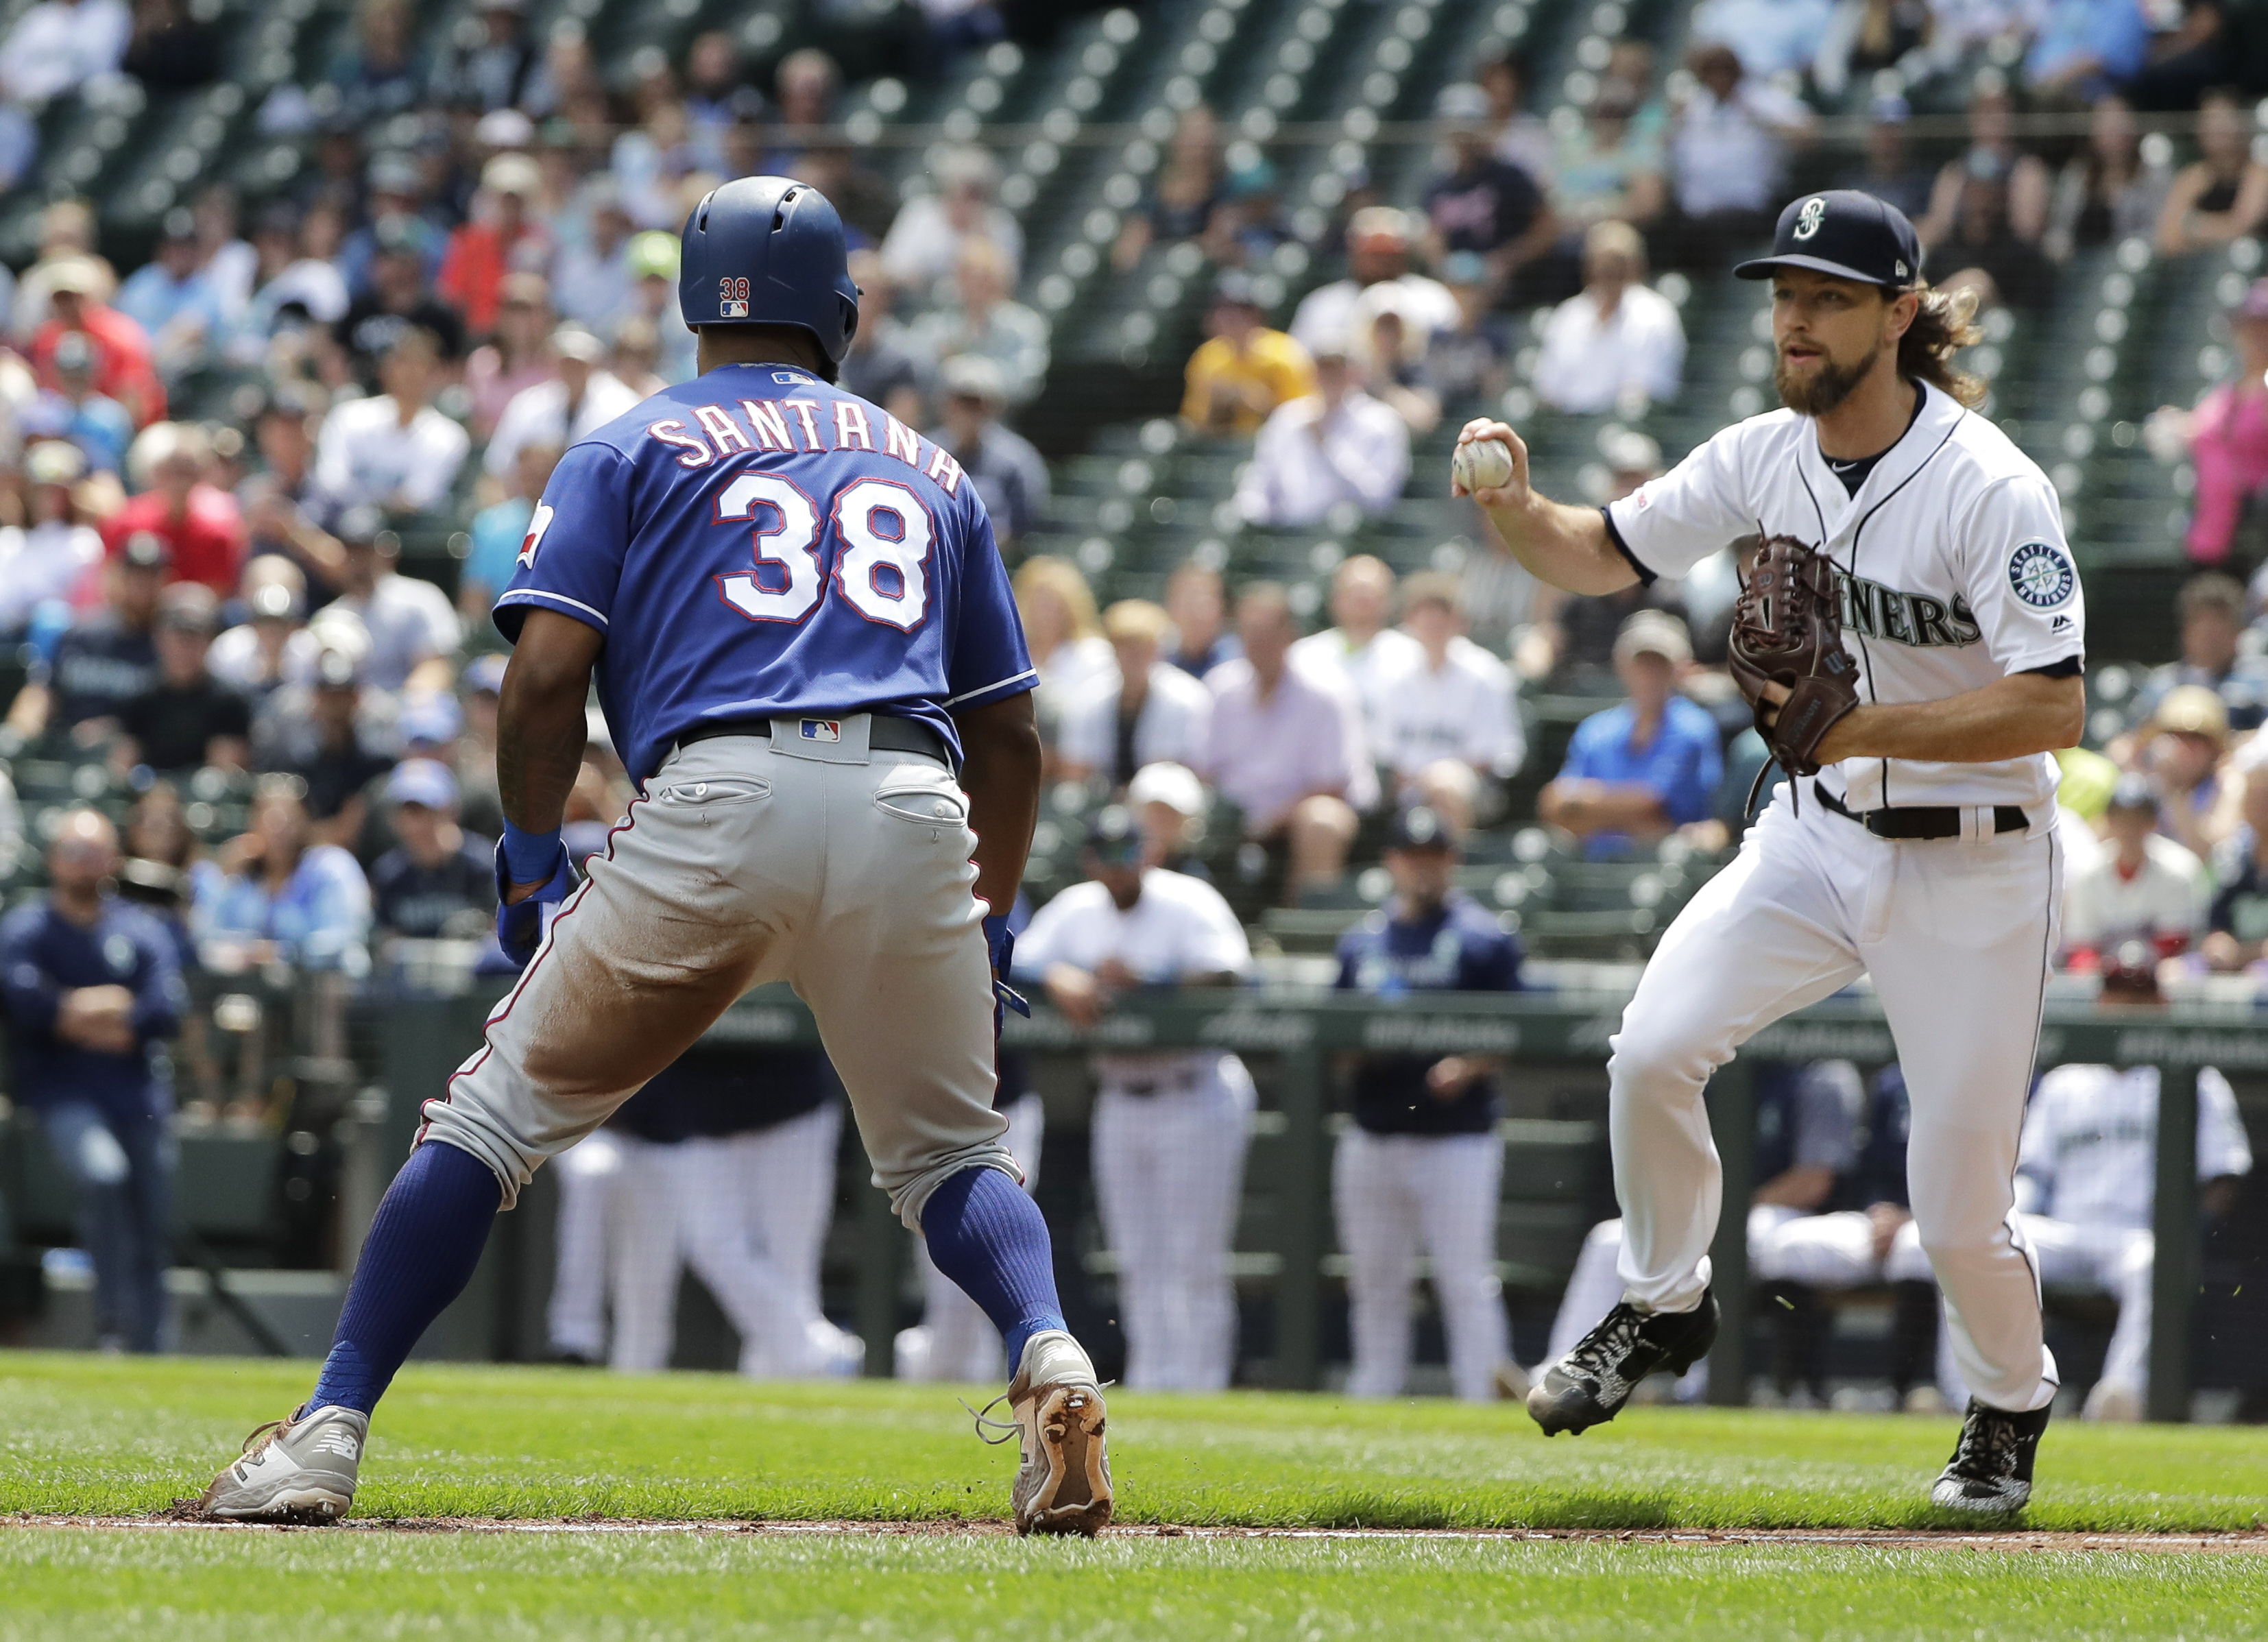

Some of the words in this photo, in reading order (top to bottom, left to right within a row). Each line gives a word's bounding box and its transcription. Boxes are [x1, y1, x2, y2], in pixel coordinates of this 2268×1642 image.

[719, 276, 750, 300] 38
[647, 399, 963, 499] SANTANA
[712, 470, 937, 633] 38
[2010, 545, 2063, 575] SEATTLE
[1834, 571, 1983, 648] NERS
[2018, 574, 2071, 605] MARINERS
